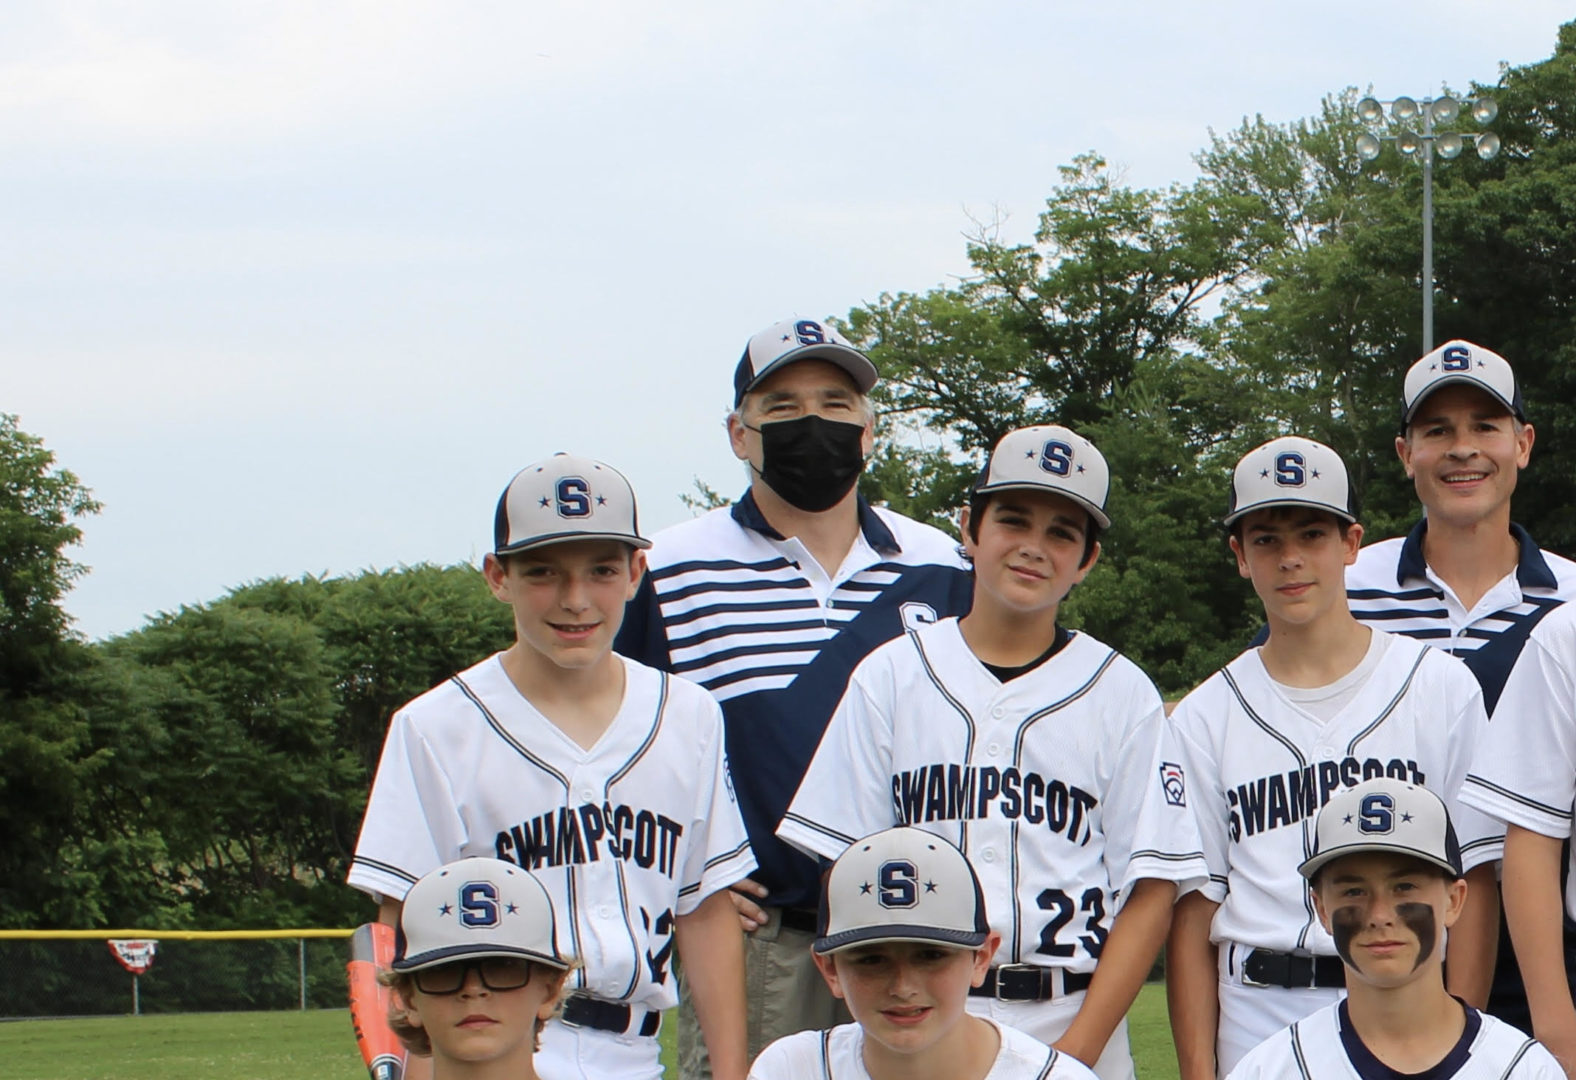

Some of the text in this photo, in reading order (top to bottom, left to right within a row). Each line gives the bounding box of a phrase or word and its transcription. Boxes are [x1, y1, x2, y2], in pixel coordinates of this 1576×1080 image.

[1441, 346, 1472, 373] S
[1039, 438, 1075, 478] S
[1274, 451, 1306, 487] S
[555, 475, 593, 519] S
[892, 764, 1097, 848] SWAMPSCOTT
[1358, 792, 1395, 835] S
[458, 880, 501, 929] S
[878, 859, 919, 909] S
[1036, 887, 1108, 958] 23
